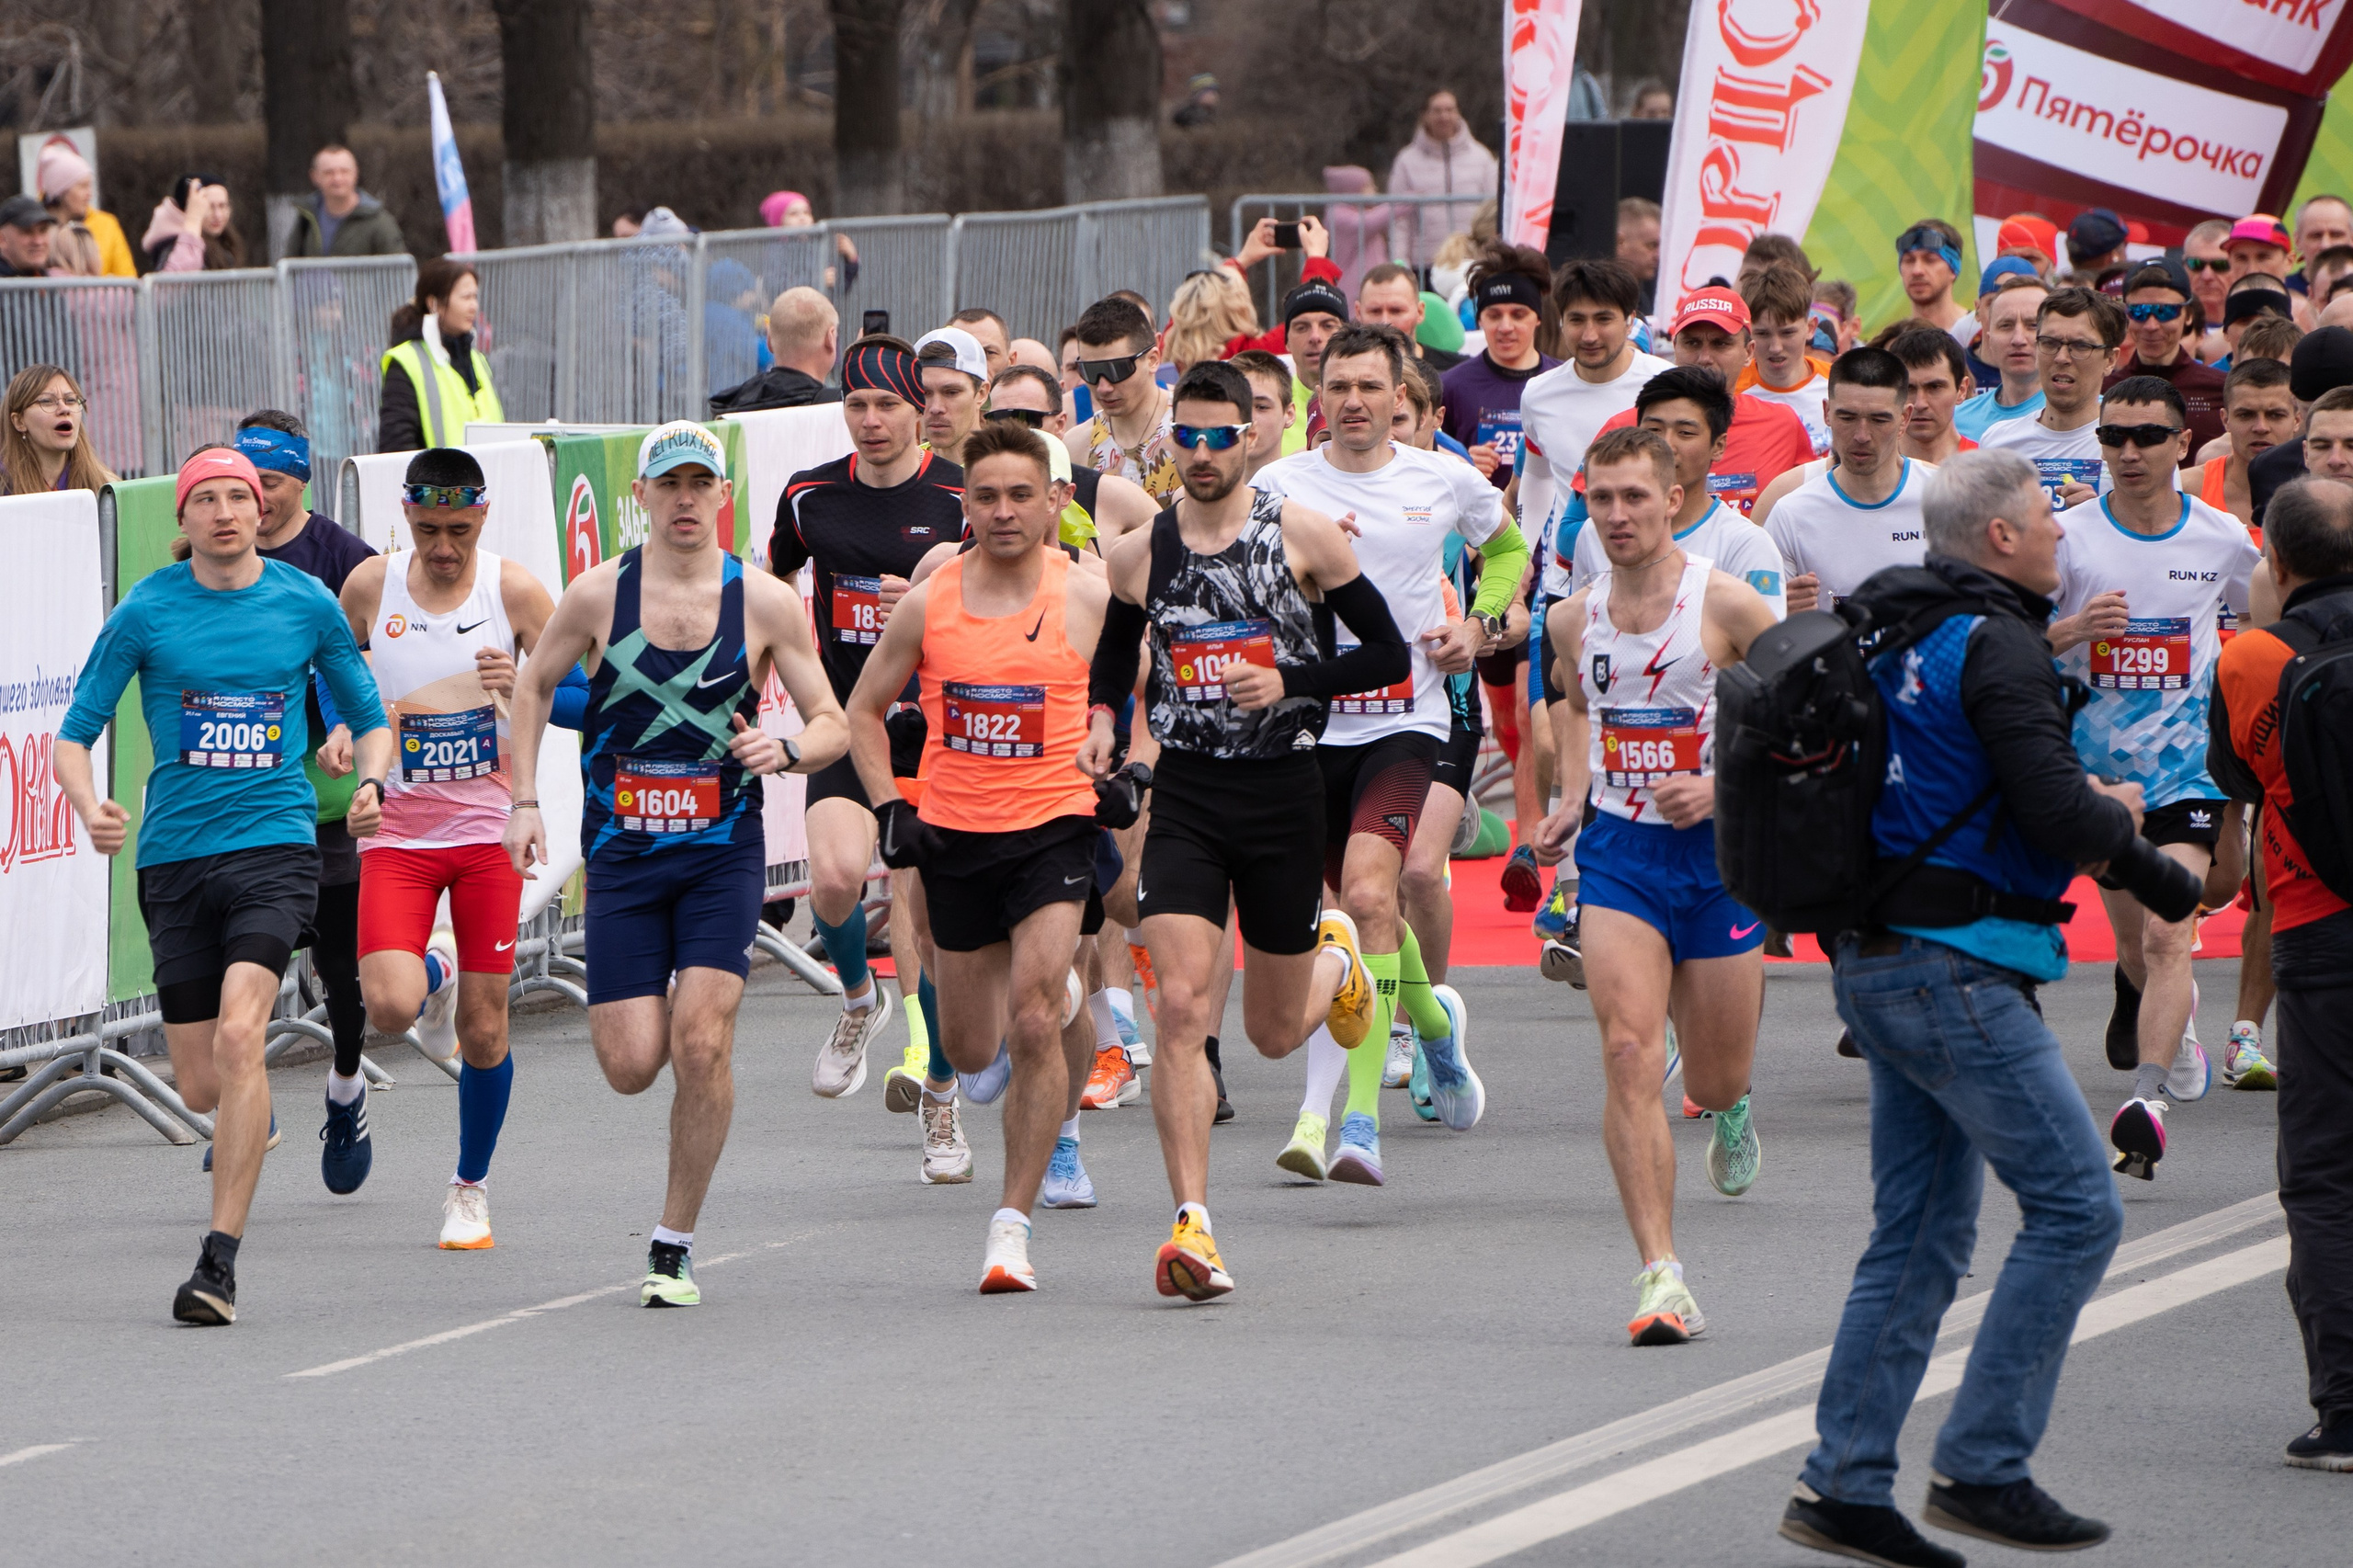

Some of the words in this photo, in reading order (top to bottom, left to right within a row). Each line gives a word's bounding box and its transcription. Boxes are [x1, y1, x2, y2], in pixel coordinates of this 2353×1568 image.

[2016, 74, 2264, 180] Пятёрочка
[1683, 298, 1733, 315] RUSSIA
[617, 495, 651, 550] ЗАБЕ
[1892, 530, 1920, 541] RUN
[2168, 570, 2198, 581] RUN
[2200, 572, 2218, 582] KZ
[410, 622, 427, 632] NN
[852, 603, 888, 630] 183
[1201, 625, 1236, 633] ПРОСТО
[1206, 642, 1224, 651] ИЛЬЯ
[2110, 647, 2169, 674] 1299
[0, 682, 26, 715] шего
[435, 714, 468, 722] ПРОСТО
[962, 711, 1021, 741] 1822
[2255, 695, 2279, 757] ИЩИ
[199, 722, 266, 751] 2006
[422, 736, 479, 767] 2021
[1619, 740, 1676, 769] 1566
[635, 789, 699, 816] 1604
